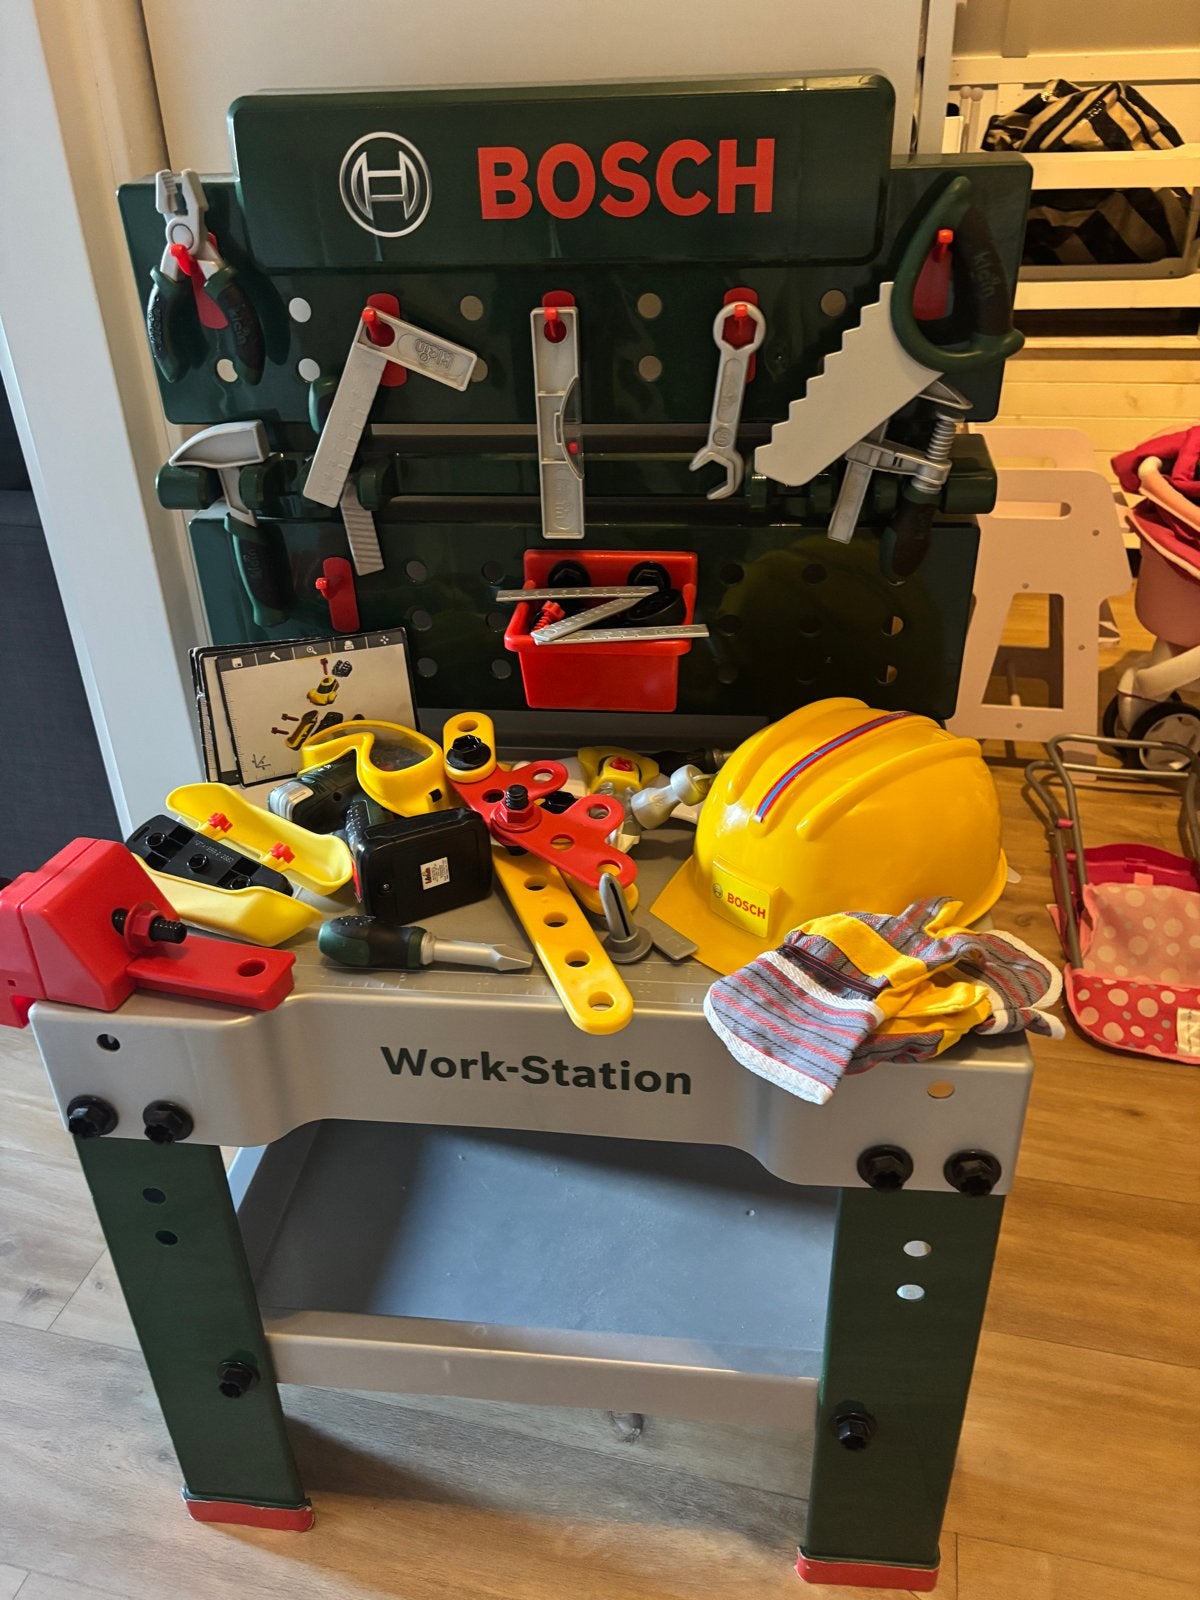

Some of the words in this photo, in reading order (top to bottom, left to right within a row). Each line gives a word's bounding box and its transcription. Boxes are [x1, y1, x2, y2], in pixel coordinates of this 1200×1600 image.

[478, 138, 775, 219] BOSCH
[727, 892, 766, 919] BOSCH
[380, 1046, 692, 1095] Work-Station
